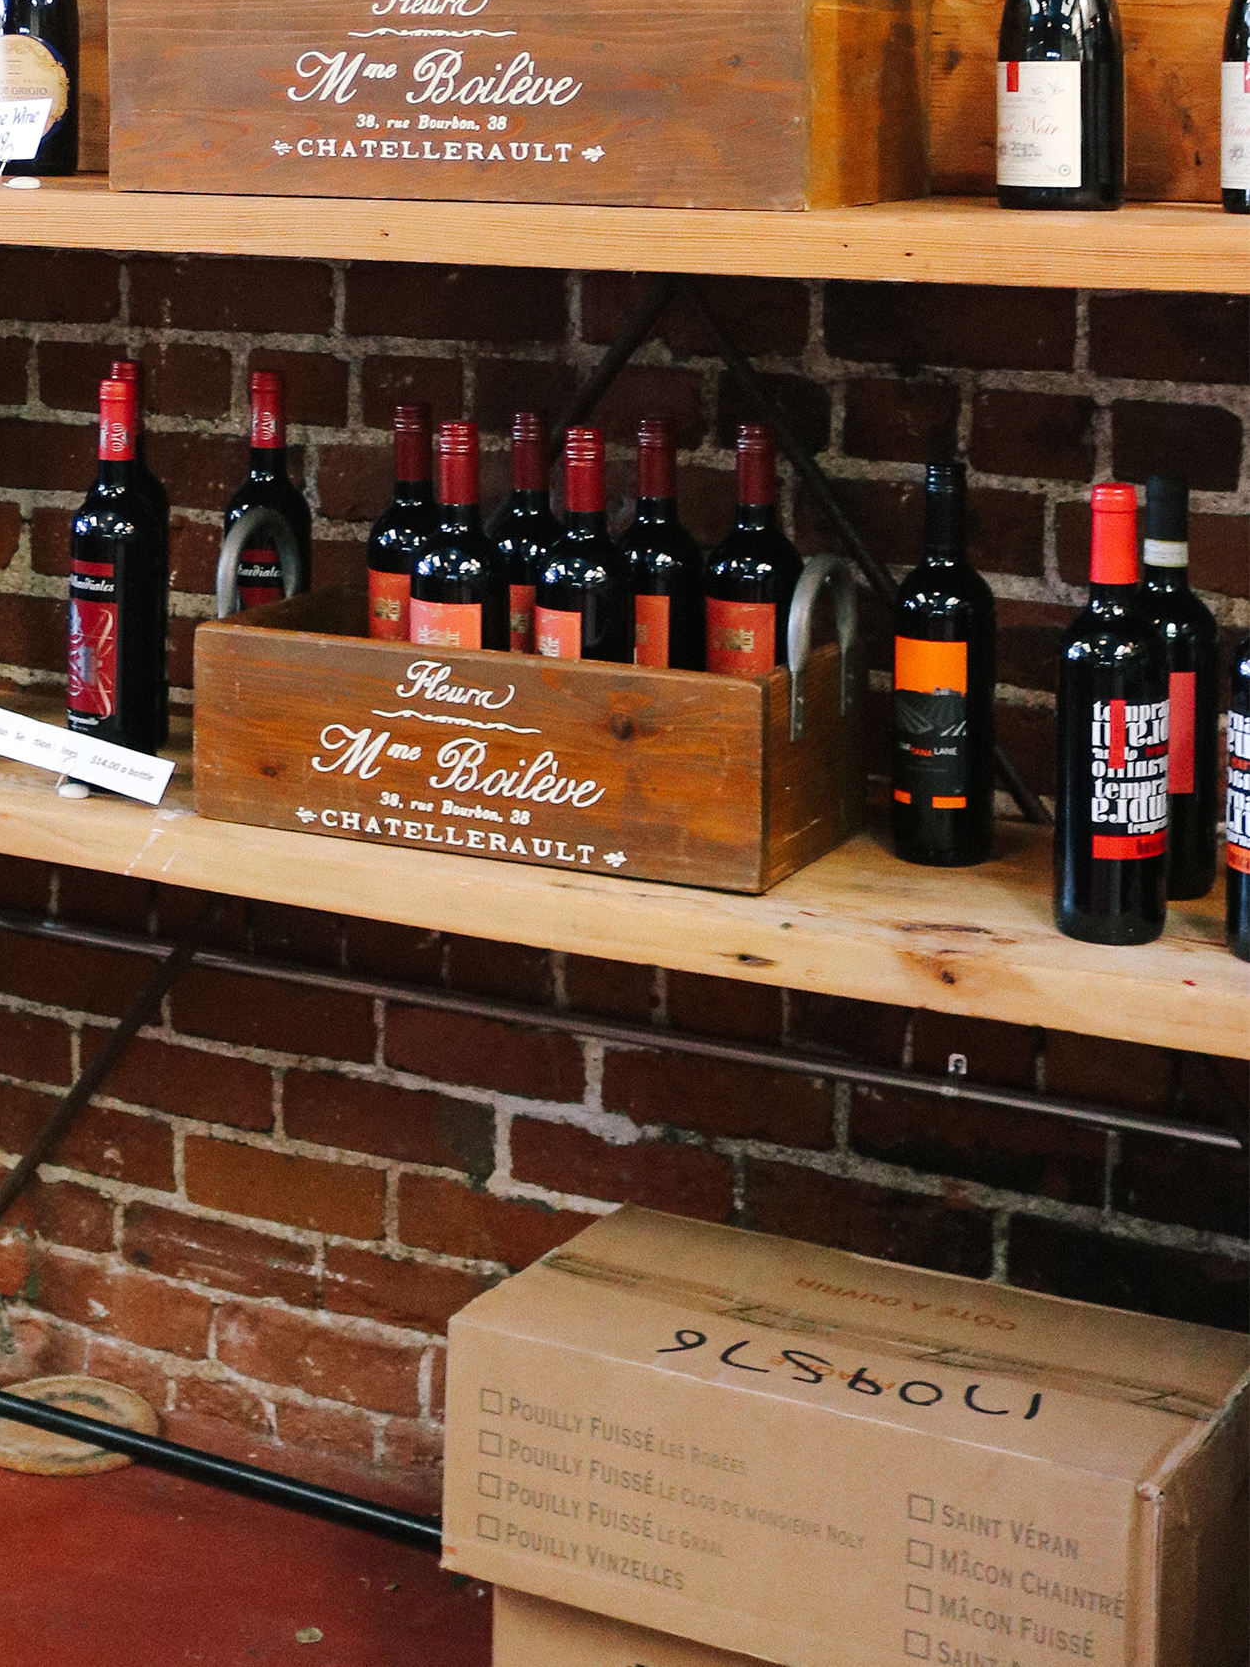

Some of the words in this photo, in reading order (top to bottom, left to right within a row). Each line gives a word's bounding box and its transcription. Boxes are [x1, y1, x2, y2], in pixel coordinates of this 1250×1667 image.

[11, 86, 48, 96] GRIGIO
[287, 50, 398, 105] Mme
[405, 47, 584, 107] Boilève
[11, 106, 41, 126] Wine
[356, 113, 380, 130] 38,
[386, 117, 410, 129] rue
[417, 114, 480, 131] Bourbon,
[486, 115, 508, 131] 38
[296, 139, 574, 163] CHATELLERAULT
[90, 754, 121, 772] $14.00
[128, 765, 155, 782] bottle
[311, 723, 422, 781] Mme
[428, 736, 607, 809] Boilève
[321, 808, 595, 865] CHATELLERAULT
[410, 800, 434, 813] rue
[509, 808, 531, 826] 38
[795, 1275, 903, 1307] OUVRIR
[509, 1396, 583, 1434] POUILLY
[589, 1417, 654, 1452] FUISSÉ
[507, 1480, 581, 1520] POUILLY
[588, 1501, 653, 1539] FUISSÉ
[508, 1438, 582, 1478] POUILLY
[589, 1459, 654, 1496] FUISSÉ
[680, 1487, 716, 1513] CLOS
[745, 1505, 821, 1538] MONSIEUR
[506, 1522, 580, 1562] POUILLY
[587, 1546, 685, 1590] VINZELLES
[942, 1504, 1002, 1539] SAINT
[1011, 1518, 1080, 1561] VÉRAN
[940, 1549, 1013, 1588] MÂCON
[1021, 1570, 1126, 1620] CHAINTRÉ
[939, 1594, 1012, 1636] MÂCON
[1019, 1616, 1095, 1660] FUISSÉ
